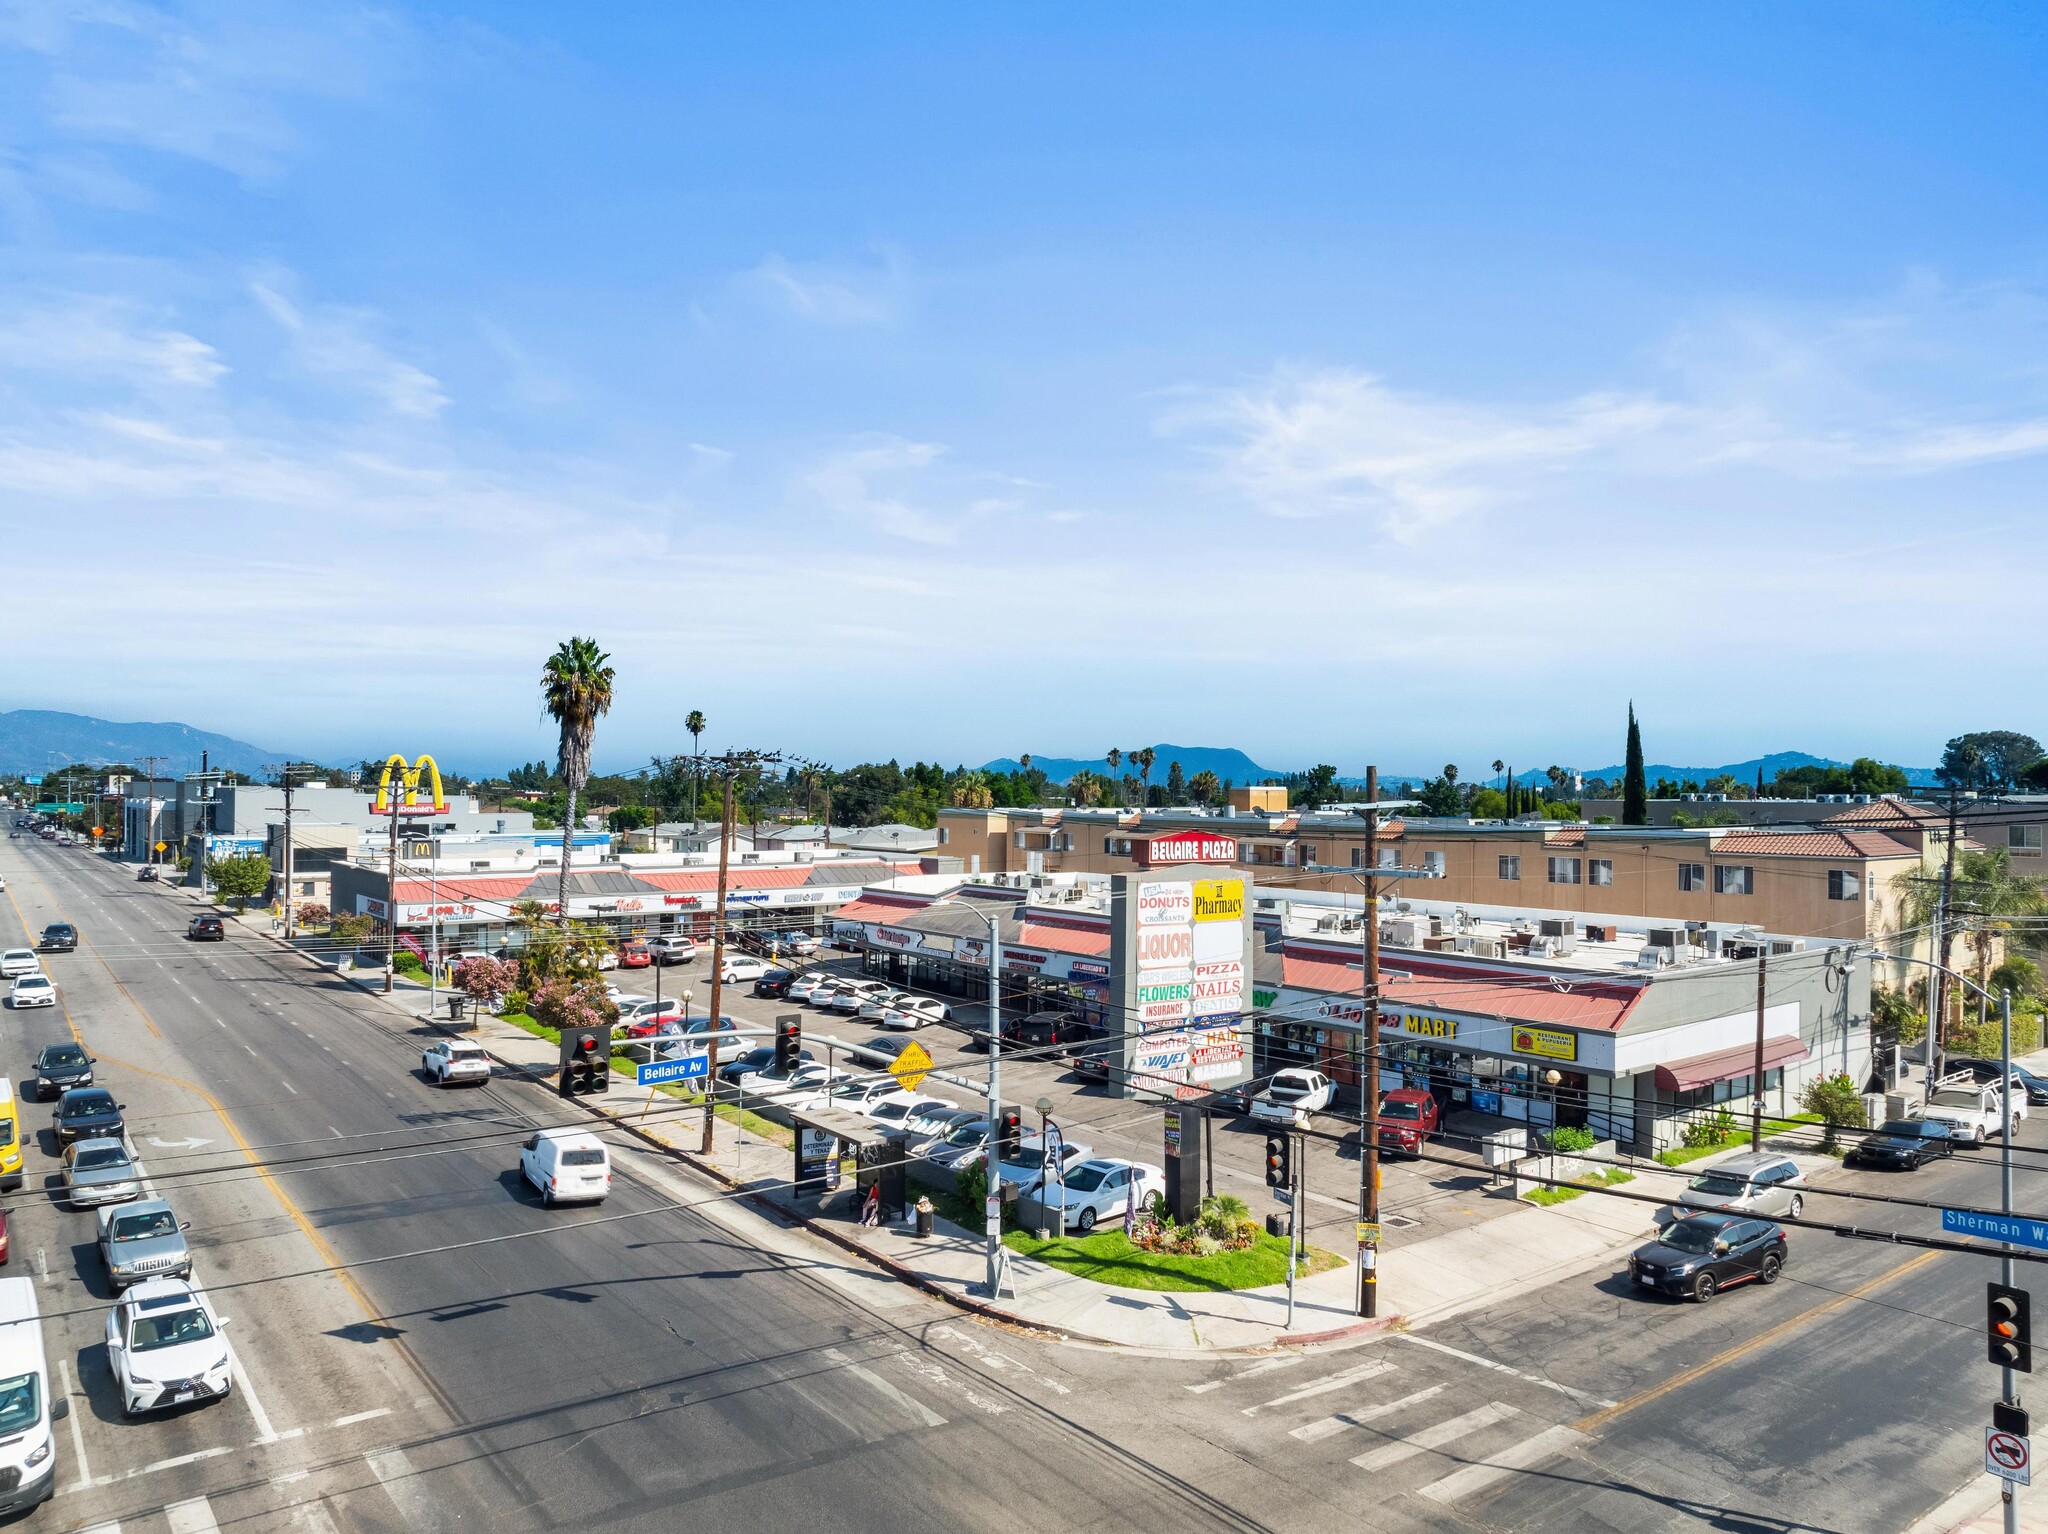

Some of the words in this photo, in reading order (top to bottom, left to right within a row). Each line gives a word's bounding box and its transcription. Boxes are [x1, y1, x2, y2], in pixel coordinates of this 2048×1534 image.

[1152, 840, 1198, 860] BELLAIRE
[1202, 840, 1234, 859] PLAZA
[838, 890, 862, 899] DENTA
[427, 905, 476, 915] DONUTS
[1140, 897, 1189, 909] DONUTS
[1195, 896, 1242, 915] Pharmacy
[1145, 915, 1185, 923] CROISSANTS
[1138, 932, 1191, 960] LIQUOR
[1197, 964, 1240, 976] PIZZA
[1139, 984, 1190, 1002] FLOWERS
[1196, 980, 1241, 997] NAILS
[1146, 1003, 1183, 1017] INSURANCE
[1196, 997, 1240, 1012] DENTIST
[1331, 1005, 1400, 1028] LIQOR
[1405, 1014, 1458, 1039] MART
[1140, 1036, 1188, 1052] COMPUTER
[1206, 1030, 1238, 1046] HAIR
[1538, 1032, 1571, 1041] RESTAURANT
[1194, 1050, 1203, 1058] LA
[1203, 1046, 1233, 1056] LIBERTAD
[1197, 1052, 1240, 1064] RESTAURANTE
[900, 1059, 925, 1067] TRAFFIC
[1148, 1052, 1186, 1069] VIAJES
[644, 1065, 685, 1080] Bellaire
[689, 1061, 702, 1073] Av
[1132, 1070, 1162, 1091] SMOKE
[1163, 1067, 1184, 1085] SHOP
[1175, 1081, 1211, 1099] 12650
[804, 1141, 836, 1150] DETERMINADO
[1947, 1210, 2020, 1237] Sherman
[1988, 1464, 2000, 1473] OVER
[2019, 1474, 2028, 1483] LBS
